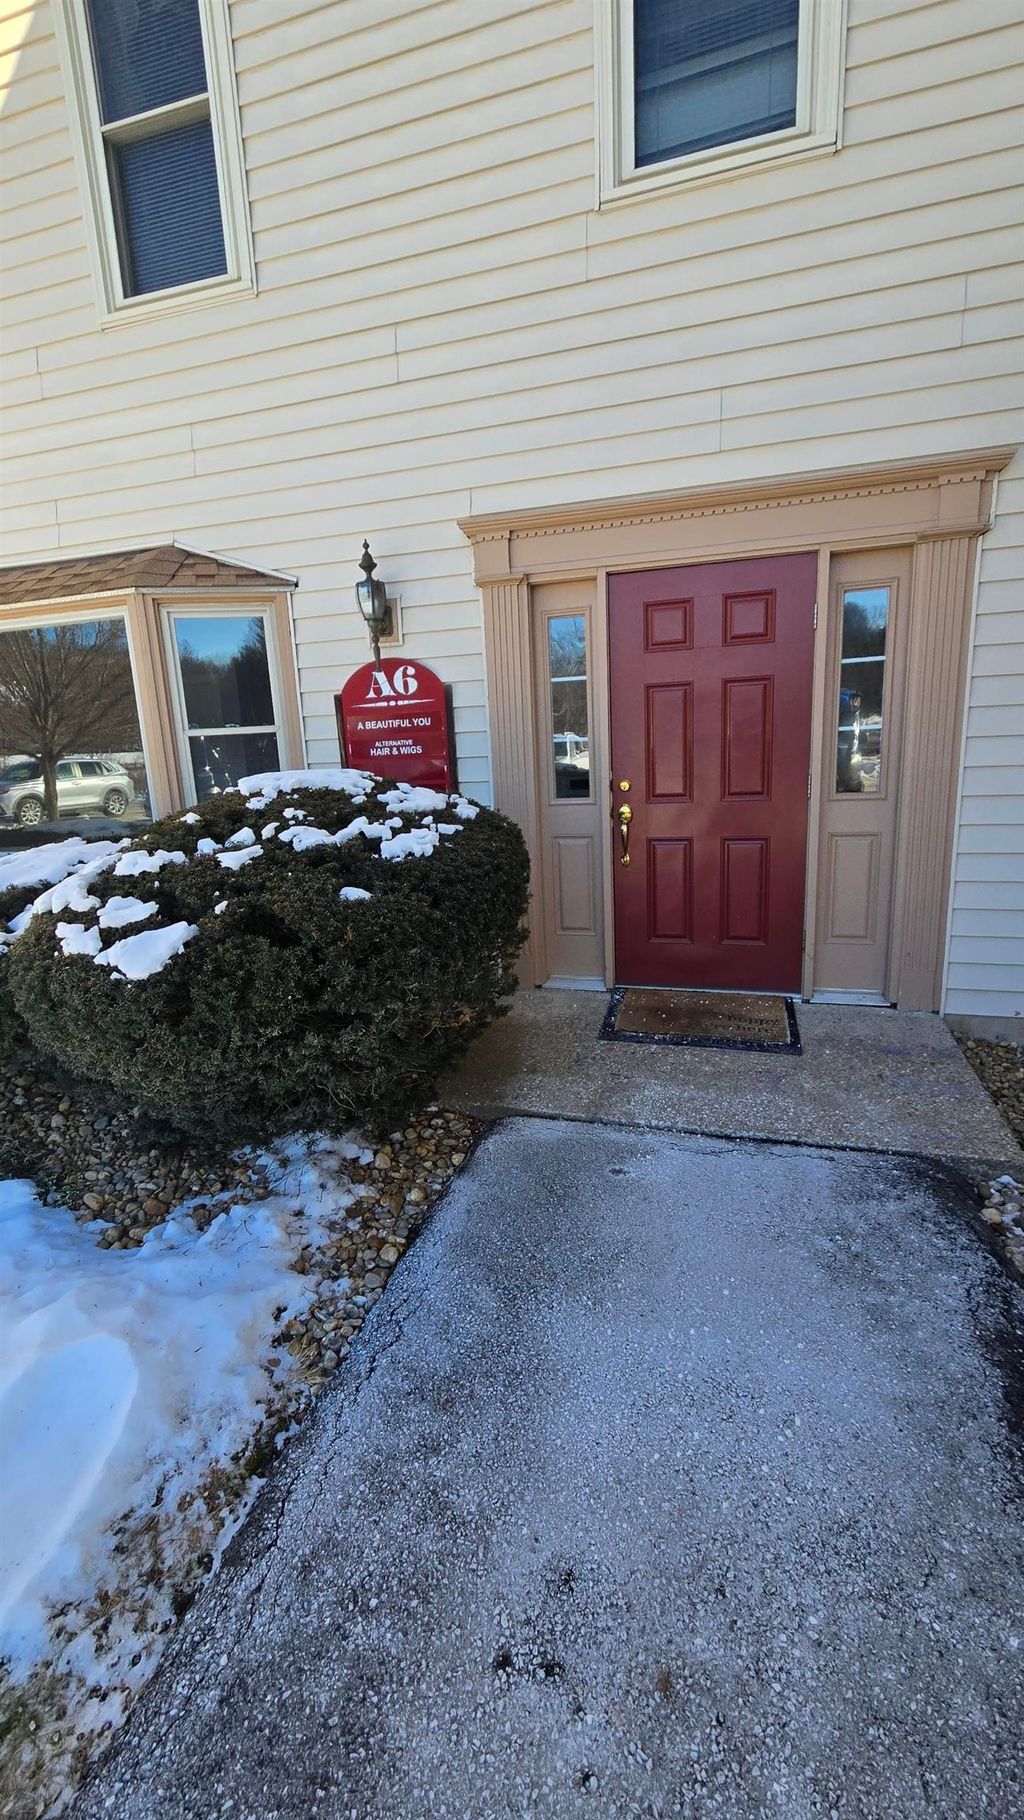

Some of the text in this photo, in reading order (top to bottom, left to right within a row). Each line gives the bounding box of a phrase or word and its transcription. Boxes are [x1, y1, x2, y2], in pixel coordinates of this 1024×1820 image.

[365, 665, 418, 698] A6
[357, 717, 431, 730] A BEAUTIFUL YOU
[375, 739, 413, 747] ALTERNATIVE
[370, 745, 422, 757] HAIR & WIGS
